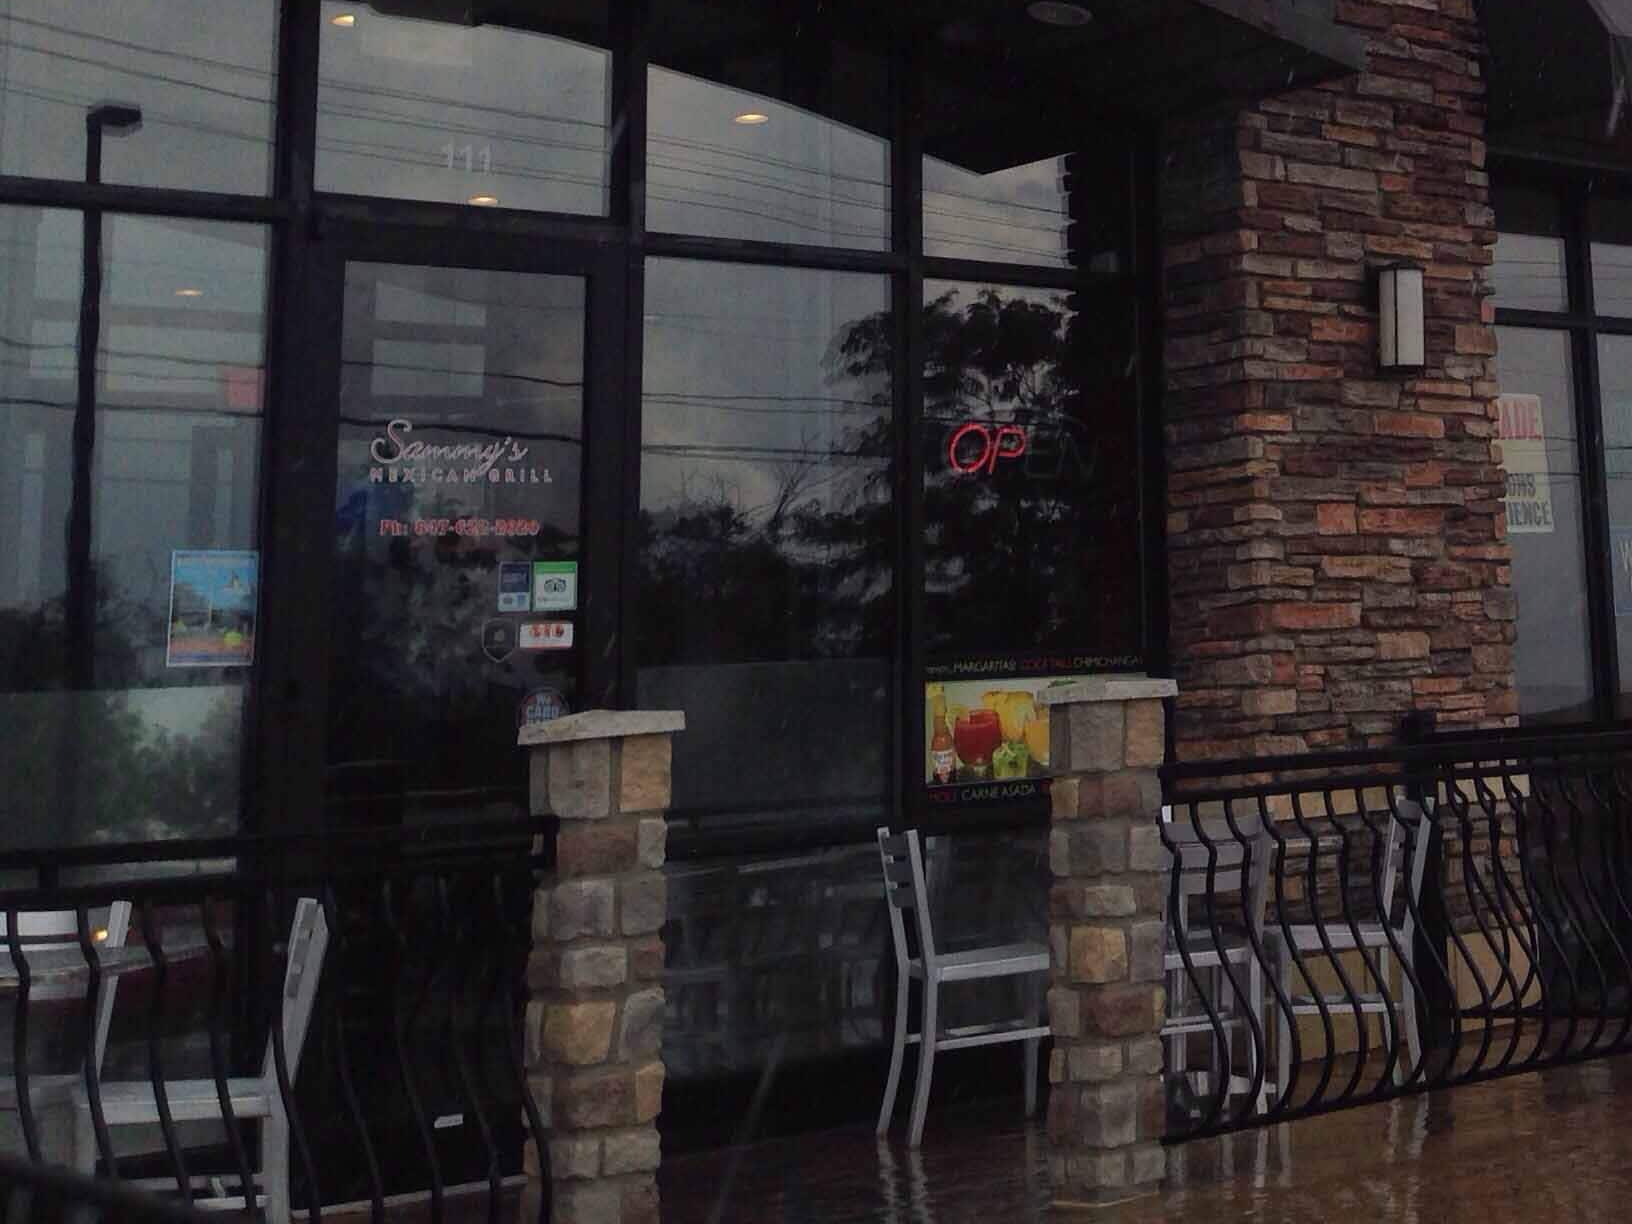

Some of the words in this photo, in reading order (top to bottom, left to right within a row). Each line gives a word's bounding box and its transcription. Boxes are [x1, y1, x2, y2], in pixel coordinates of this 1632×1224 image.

[1499, 402, 1541, 440] ADE
[370, 419, 528, 476] Sammy's
[369, 467, 477, 484] MEXICAN
[488, 468, 553, 484] GRILL
[1507, 500, 1553, 527] IENCE
